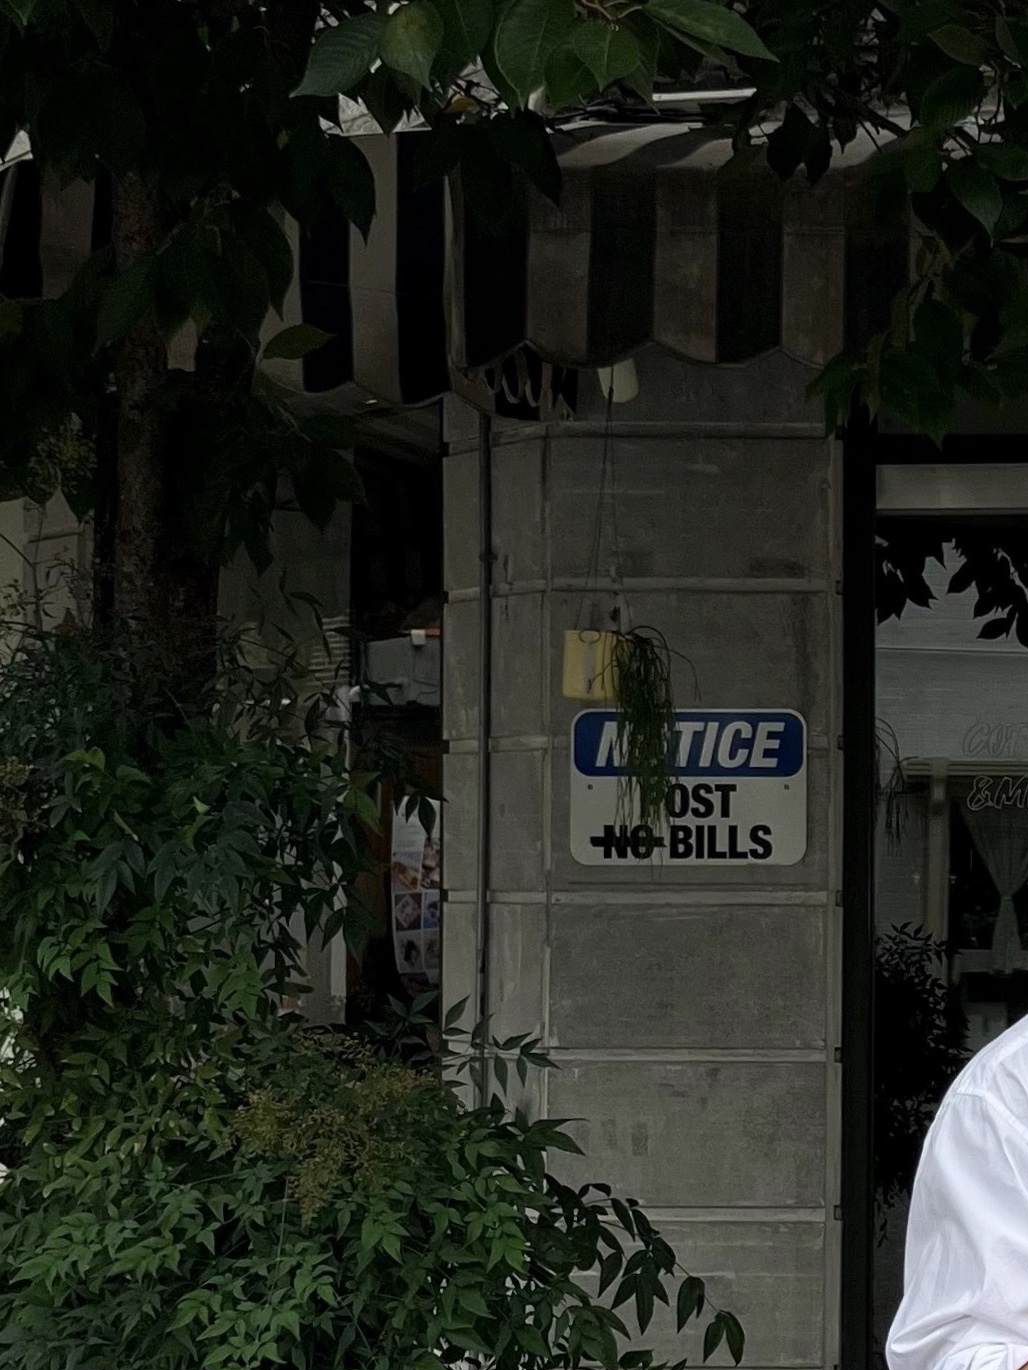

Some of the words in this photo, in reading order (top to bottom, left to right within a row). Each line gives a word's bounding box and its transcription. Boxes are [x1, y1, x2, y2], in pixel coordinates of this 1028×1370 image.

[595, 721, 785, 769] NTICE
[643, 783, 737, 818] OST
[603, 825, 654, 859] NO
[669, 825, 773, 859] BILLS
